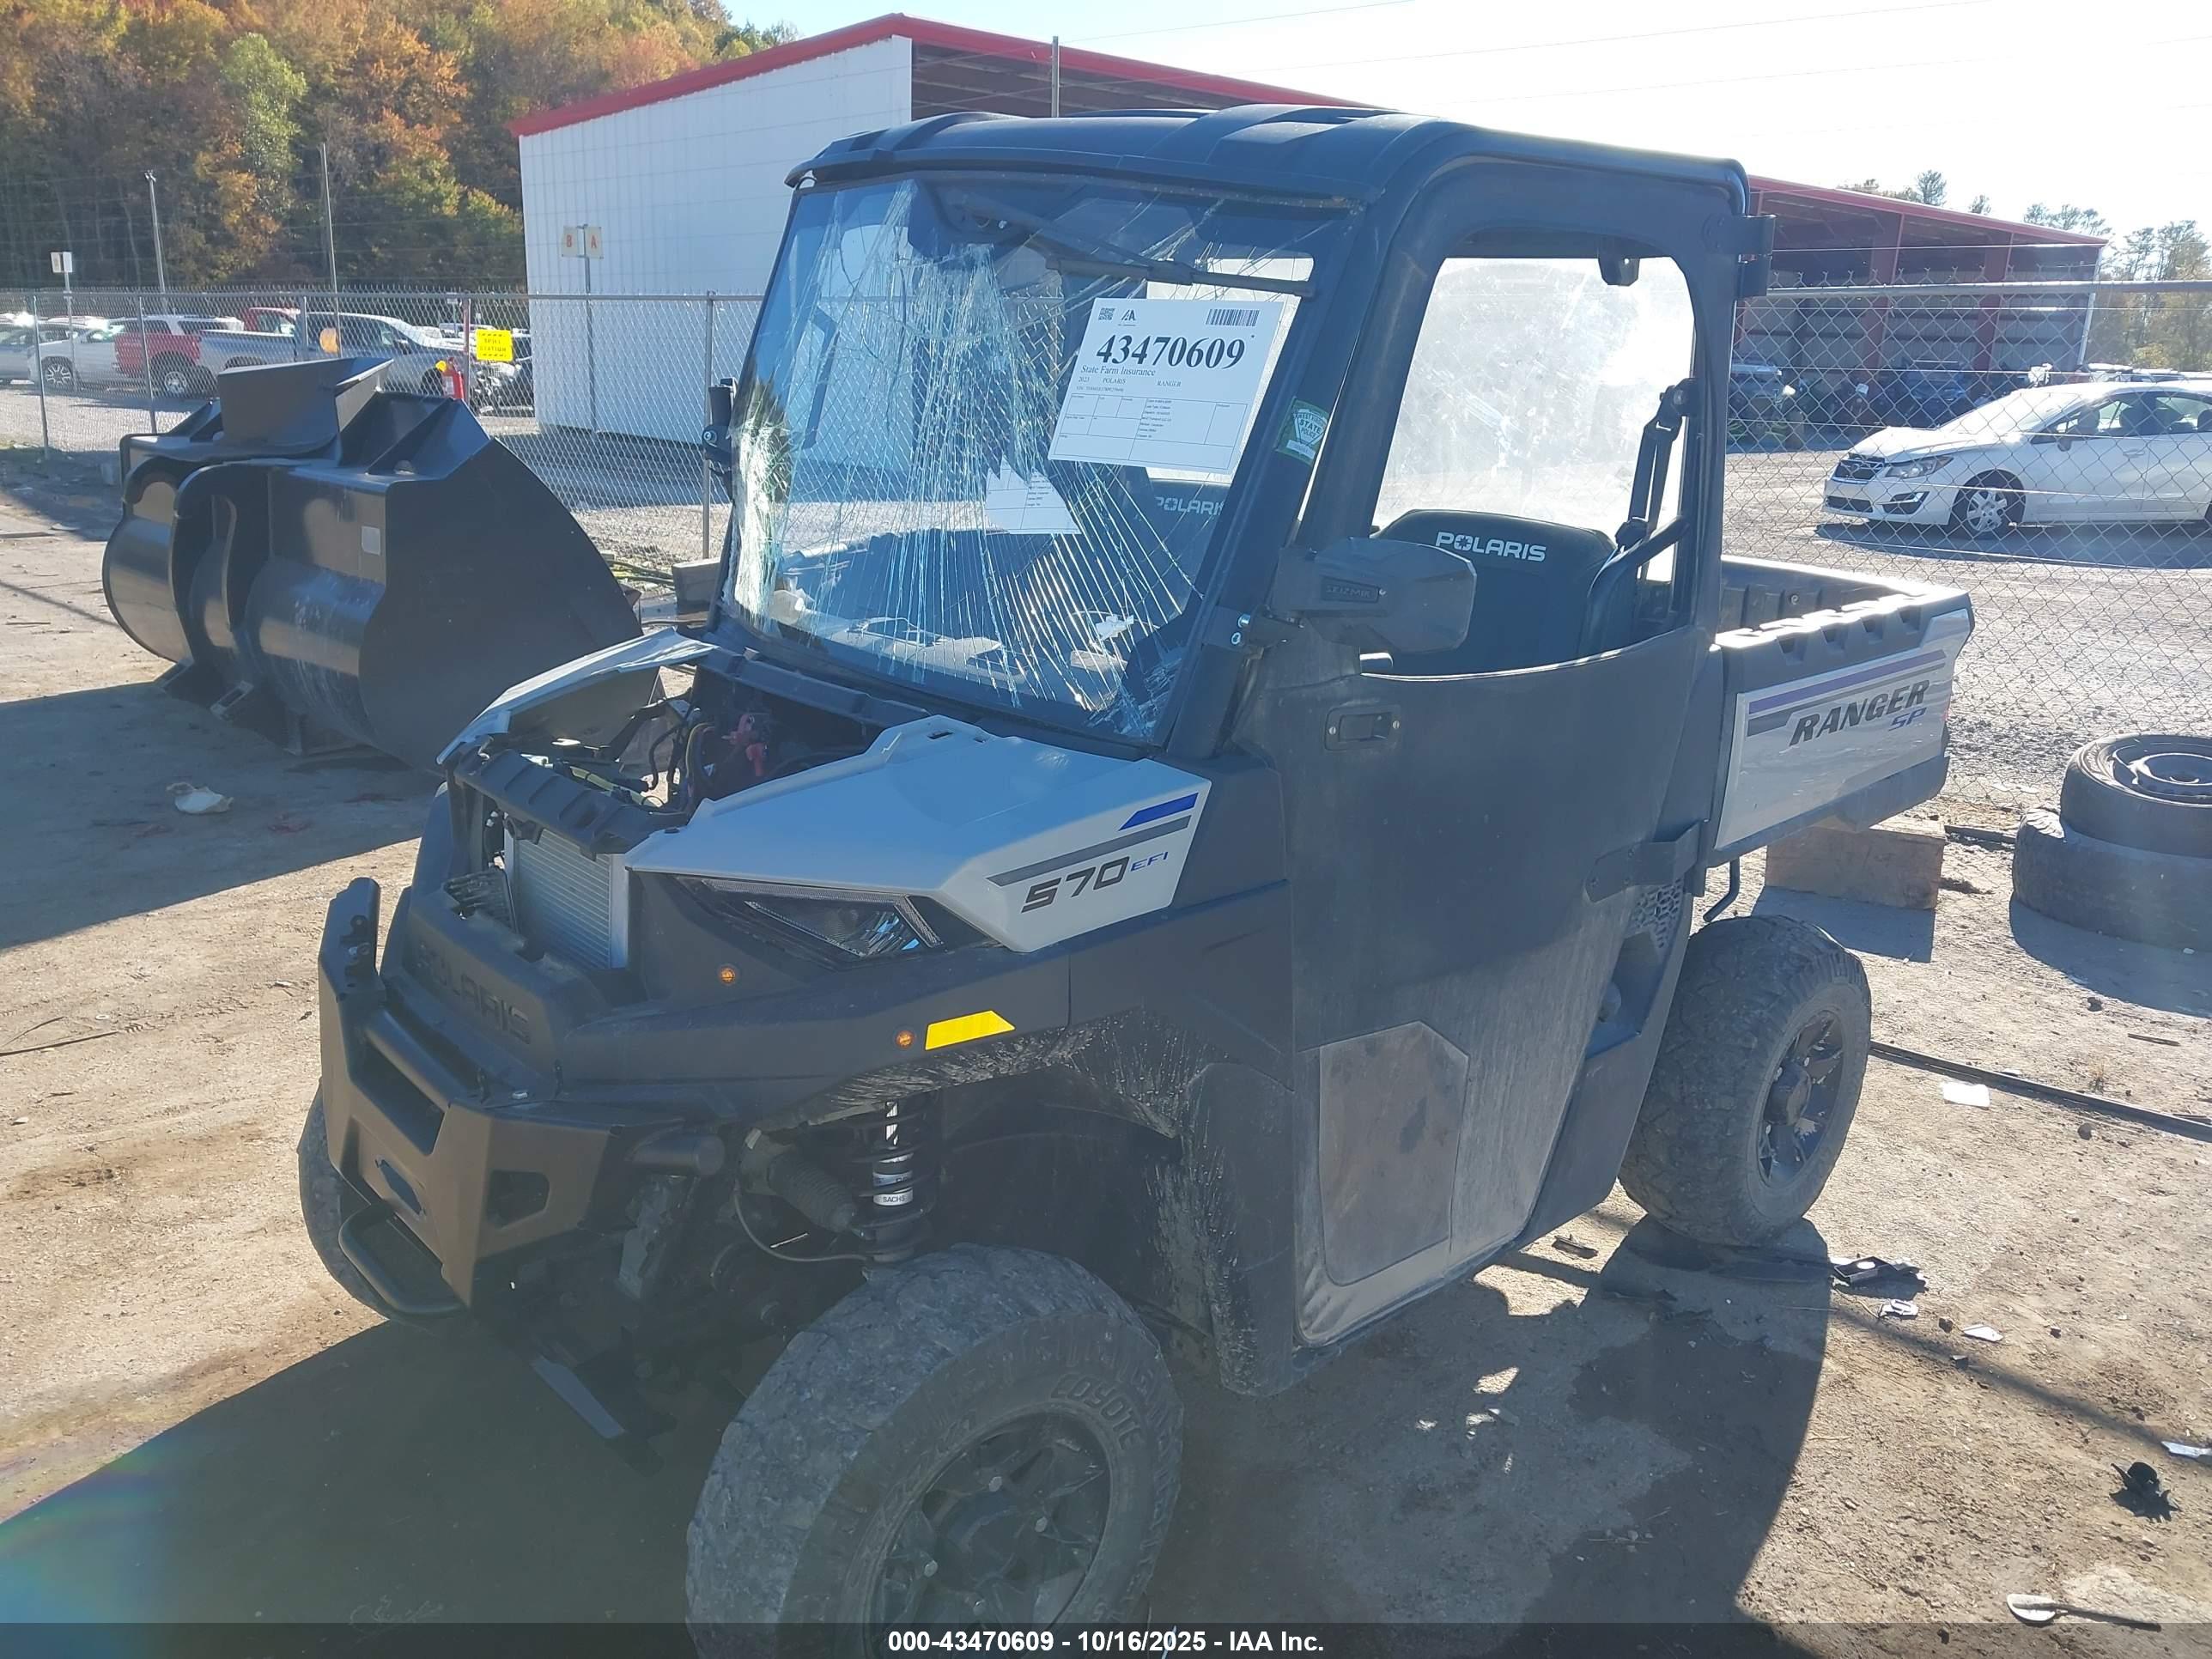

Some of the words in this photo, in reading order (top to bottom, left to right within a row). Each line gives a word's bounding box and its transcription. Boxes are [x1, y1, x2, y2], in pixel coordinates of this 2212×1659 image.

[590, 234, 599, 248] A
[1097, 334, 1246, 369] 43470609
[1080, 364, 1099, 374] State
[1100, 365, 1119, 374] Farm
[1120, 366, 1157, 377] Insurance
[1157, 380, 1182, 388] RANGER
[1299, 419, 1322, 434] STATE
[1435, 532, 1547, 562] POLARIS
[1789, 679, 1931, 746] RANGER
[1889, 707, 1928, 732] SP
[1021, 856, 1130, 914] 570
[1130, 851, 1169, 872] EFI
[417, 939, 532, 1045] POLARIS
[882, 1194, 905, 1203] SACHS
[1050, 1374, 1143, 1451] COYOTE
